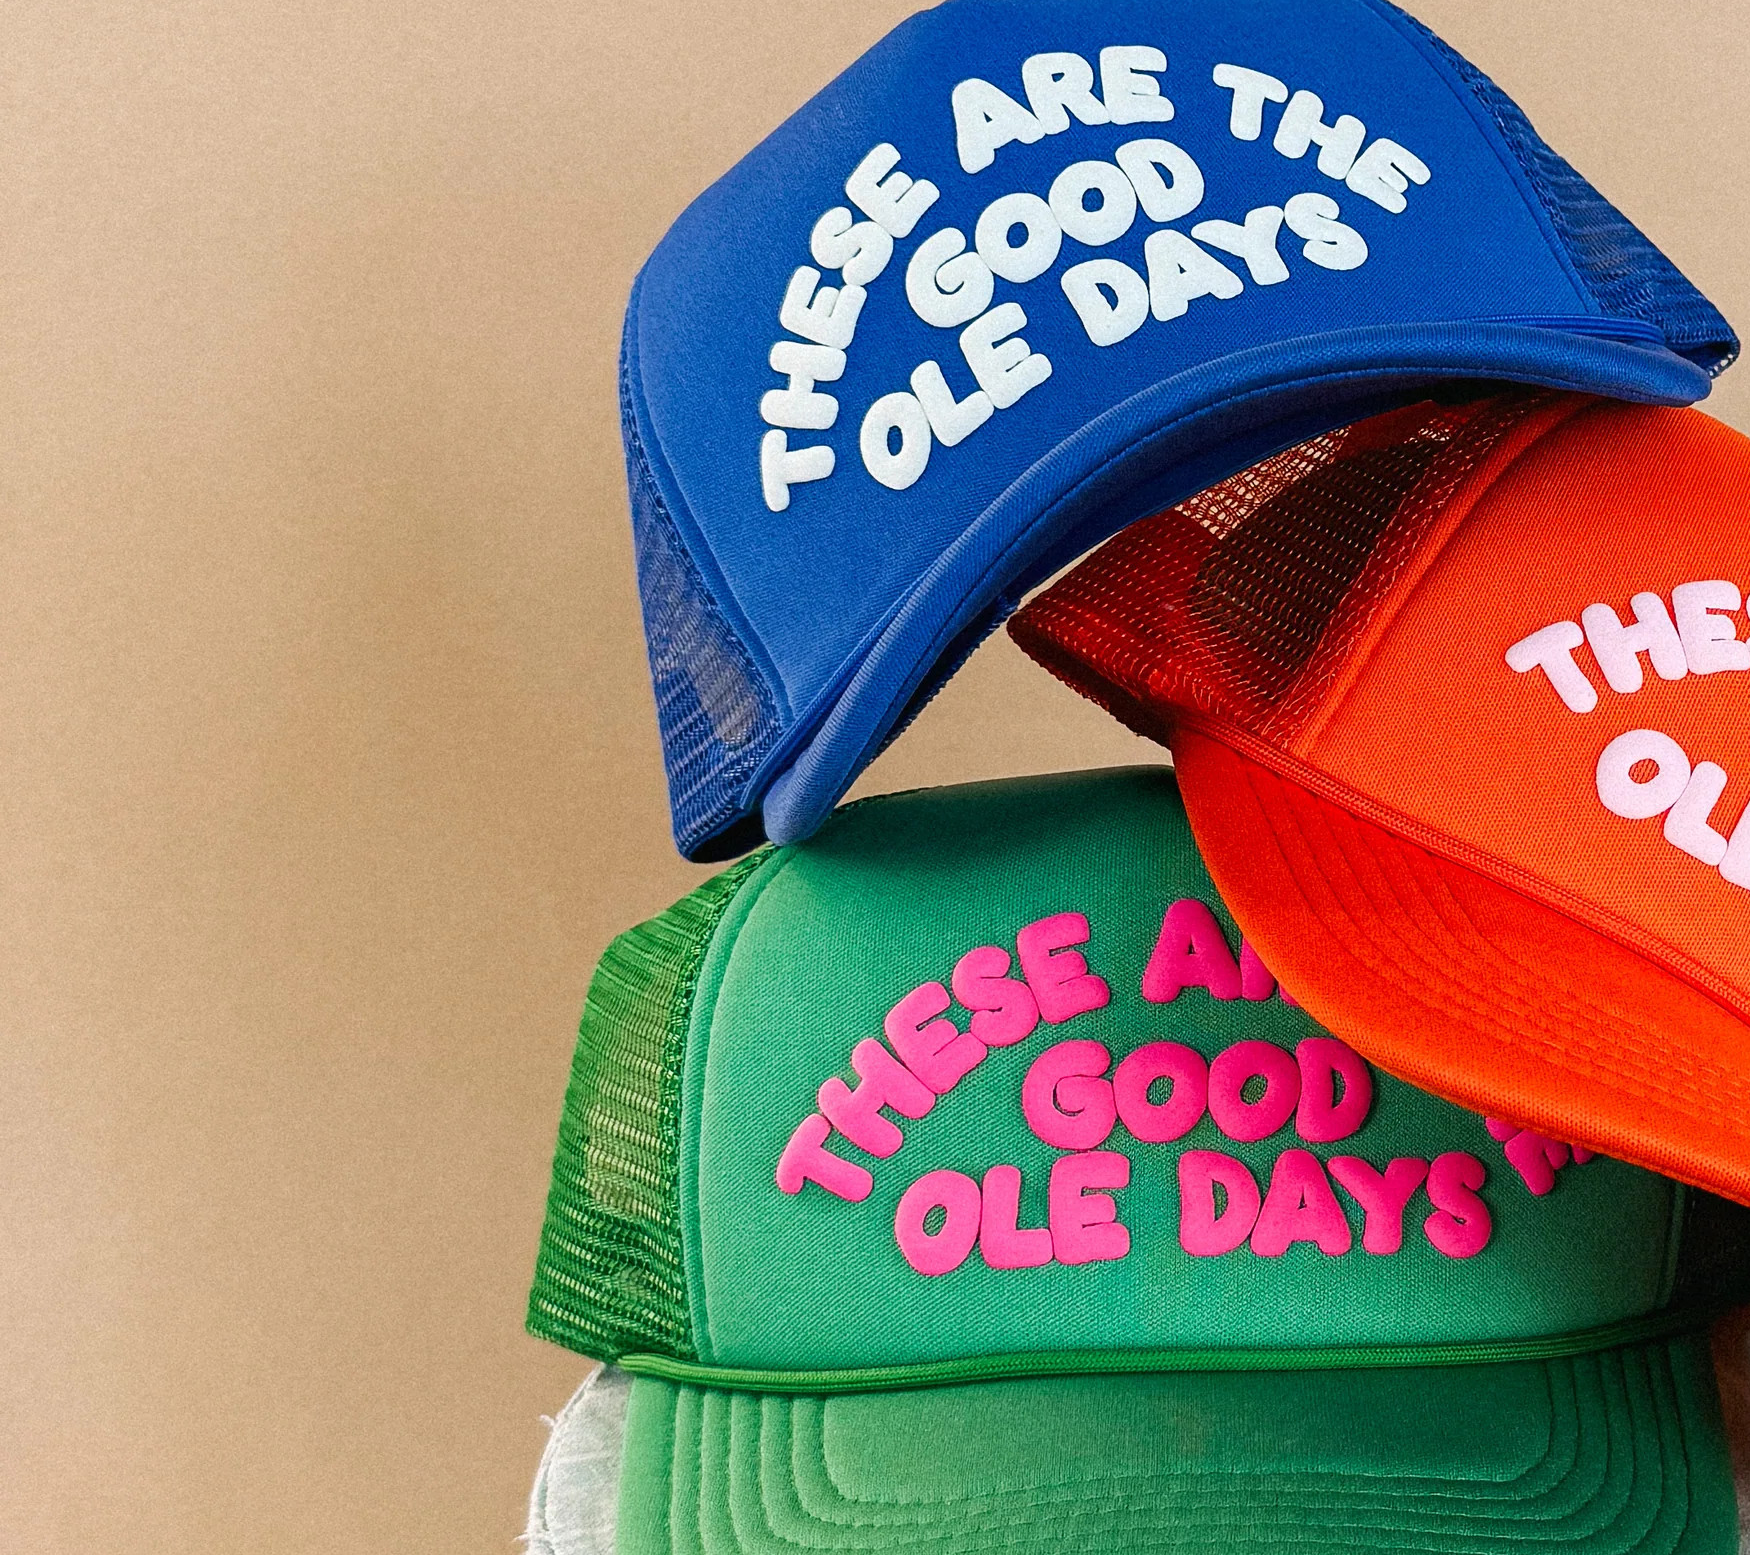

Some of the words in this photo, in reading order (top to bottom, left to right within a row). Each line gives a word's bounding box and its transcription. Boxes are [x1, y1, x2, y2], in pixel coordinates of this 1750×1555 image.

[759, 142, 939, 512] THESE
[951, 45, 1175, 174] ARE
[1212, 63, 1431, 214] THE
[859, 302, 1052, 491] OLE
[1060, 192, 1369, 347] DAYS
[905, 138, 1204, 328] GOOD
[775, 912, 1110, 1203] THESE
[1021, 1038, 1372, 1150] GOOD
[895, 1150, 1130, 1276] OLE
[1177, 1148, 1492, 1259] DAYS
